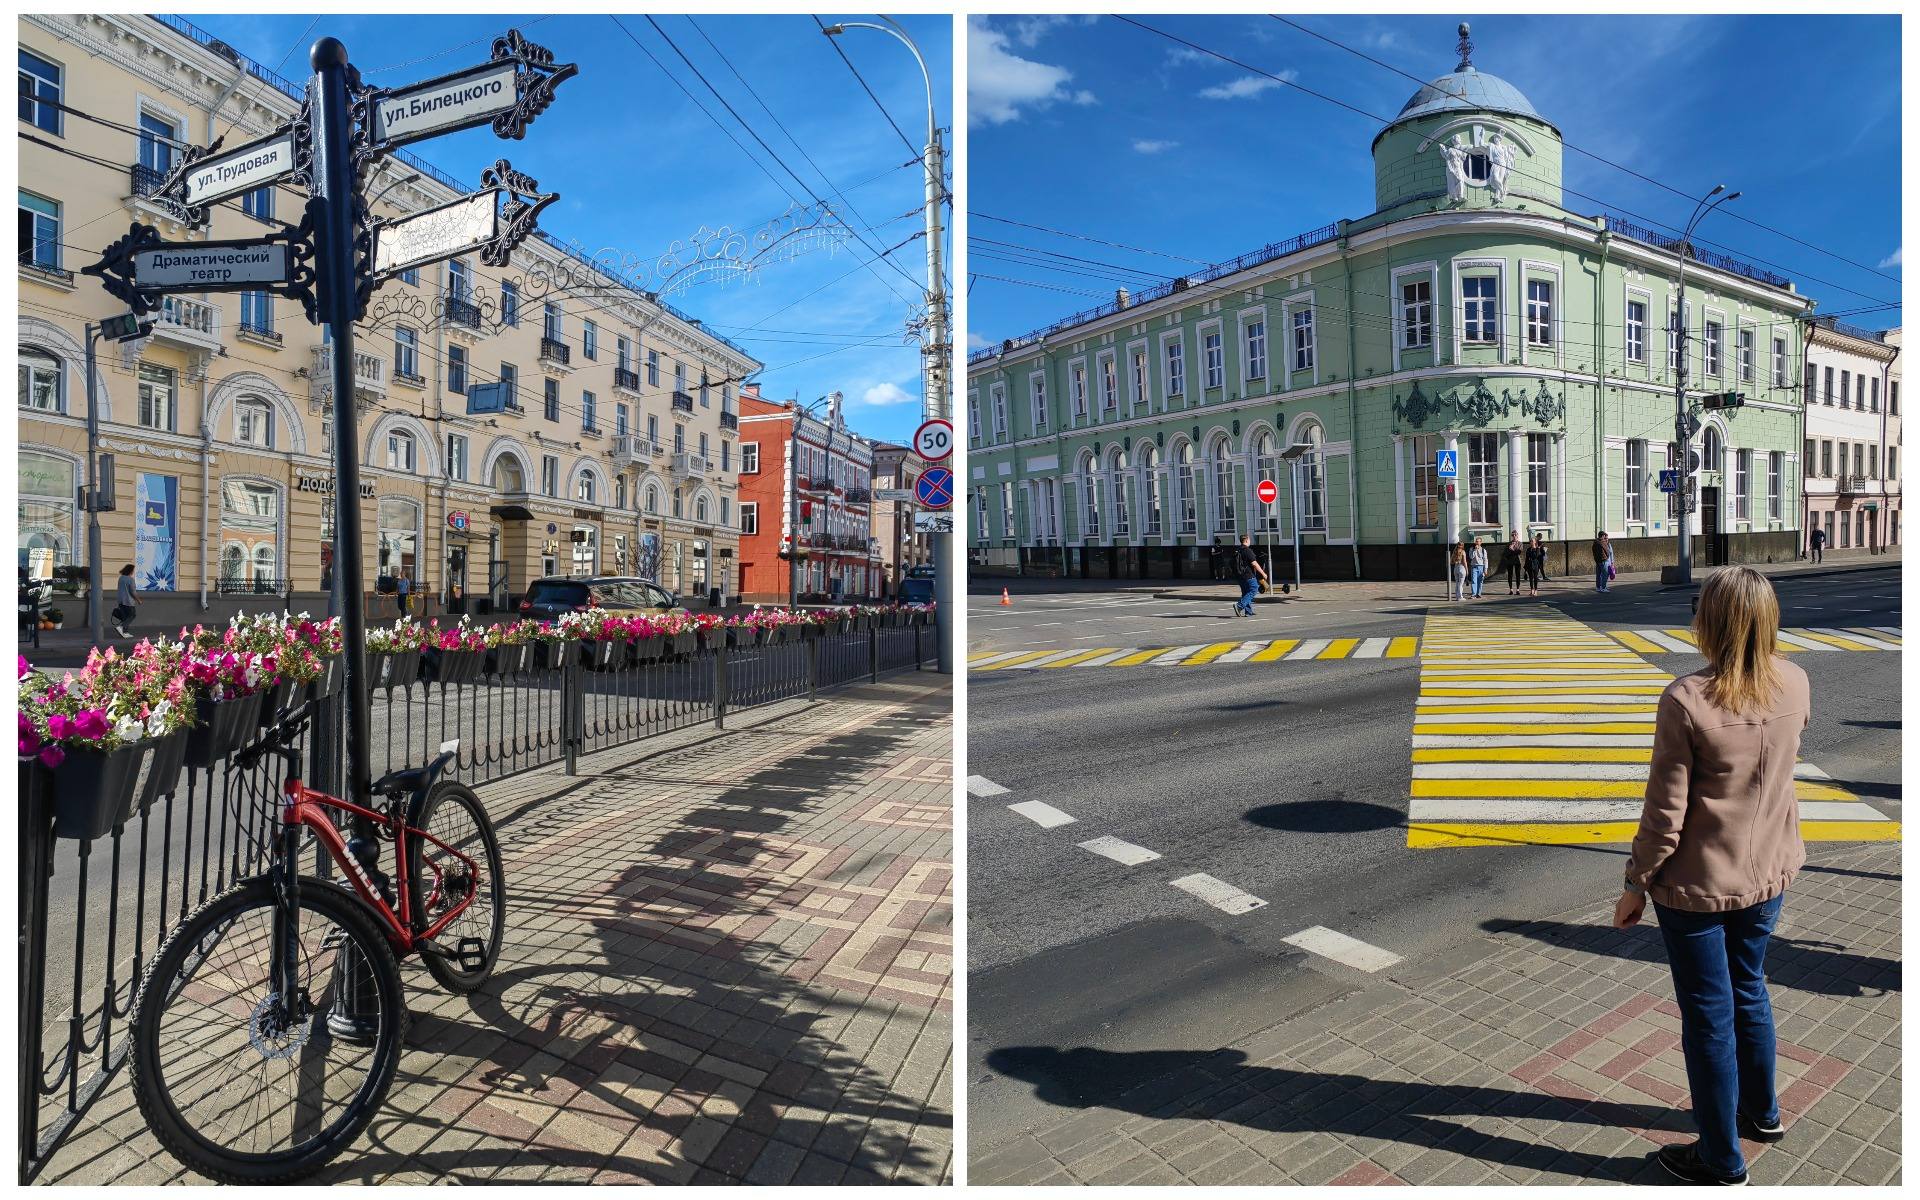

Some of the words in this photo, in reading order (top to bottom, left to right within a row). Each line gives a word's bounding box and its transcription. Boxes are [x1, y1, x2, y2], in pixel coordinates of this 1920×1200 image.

[386, 80, 502, 127] ул.Билецкого
[198, 150, 277, 191] ул.Трудовая
[152, 250, 270, 269] Драматический
[190, 268, 232, 281] театр
[923, 431, 948, 450] 50
